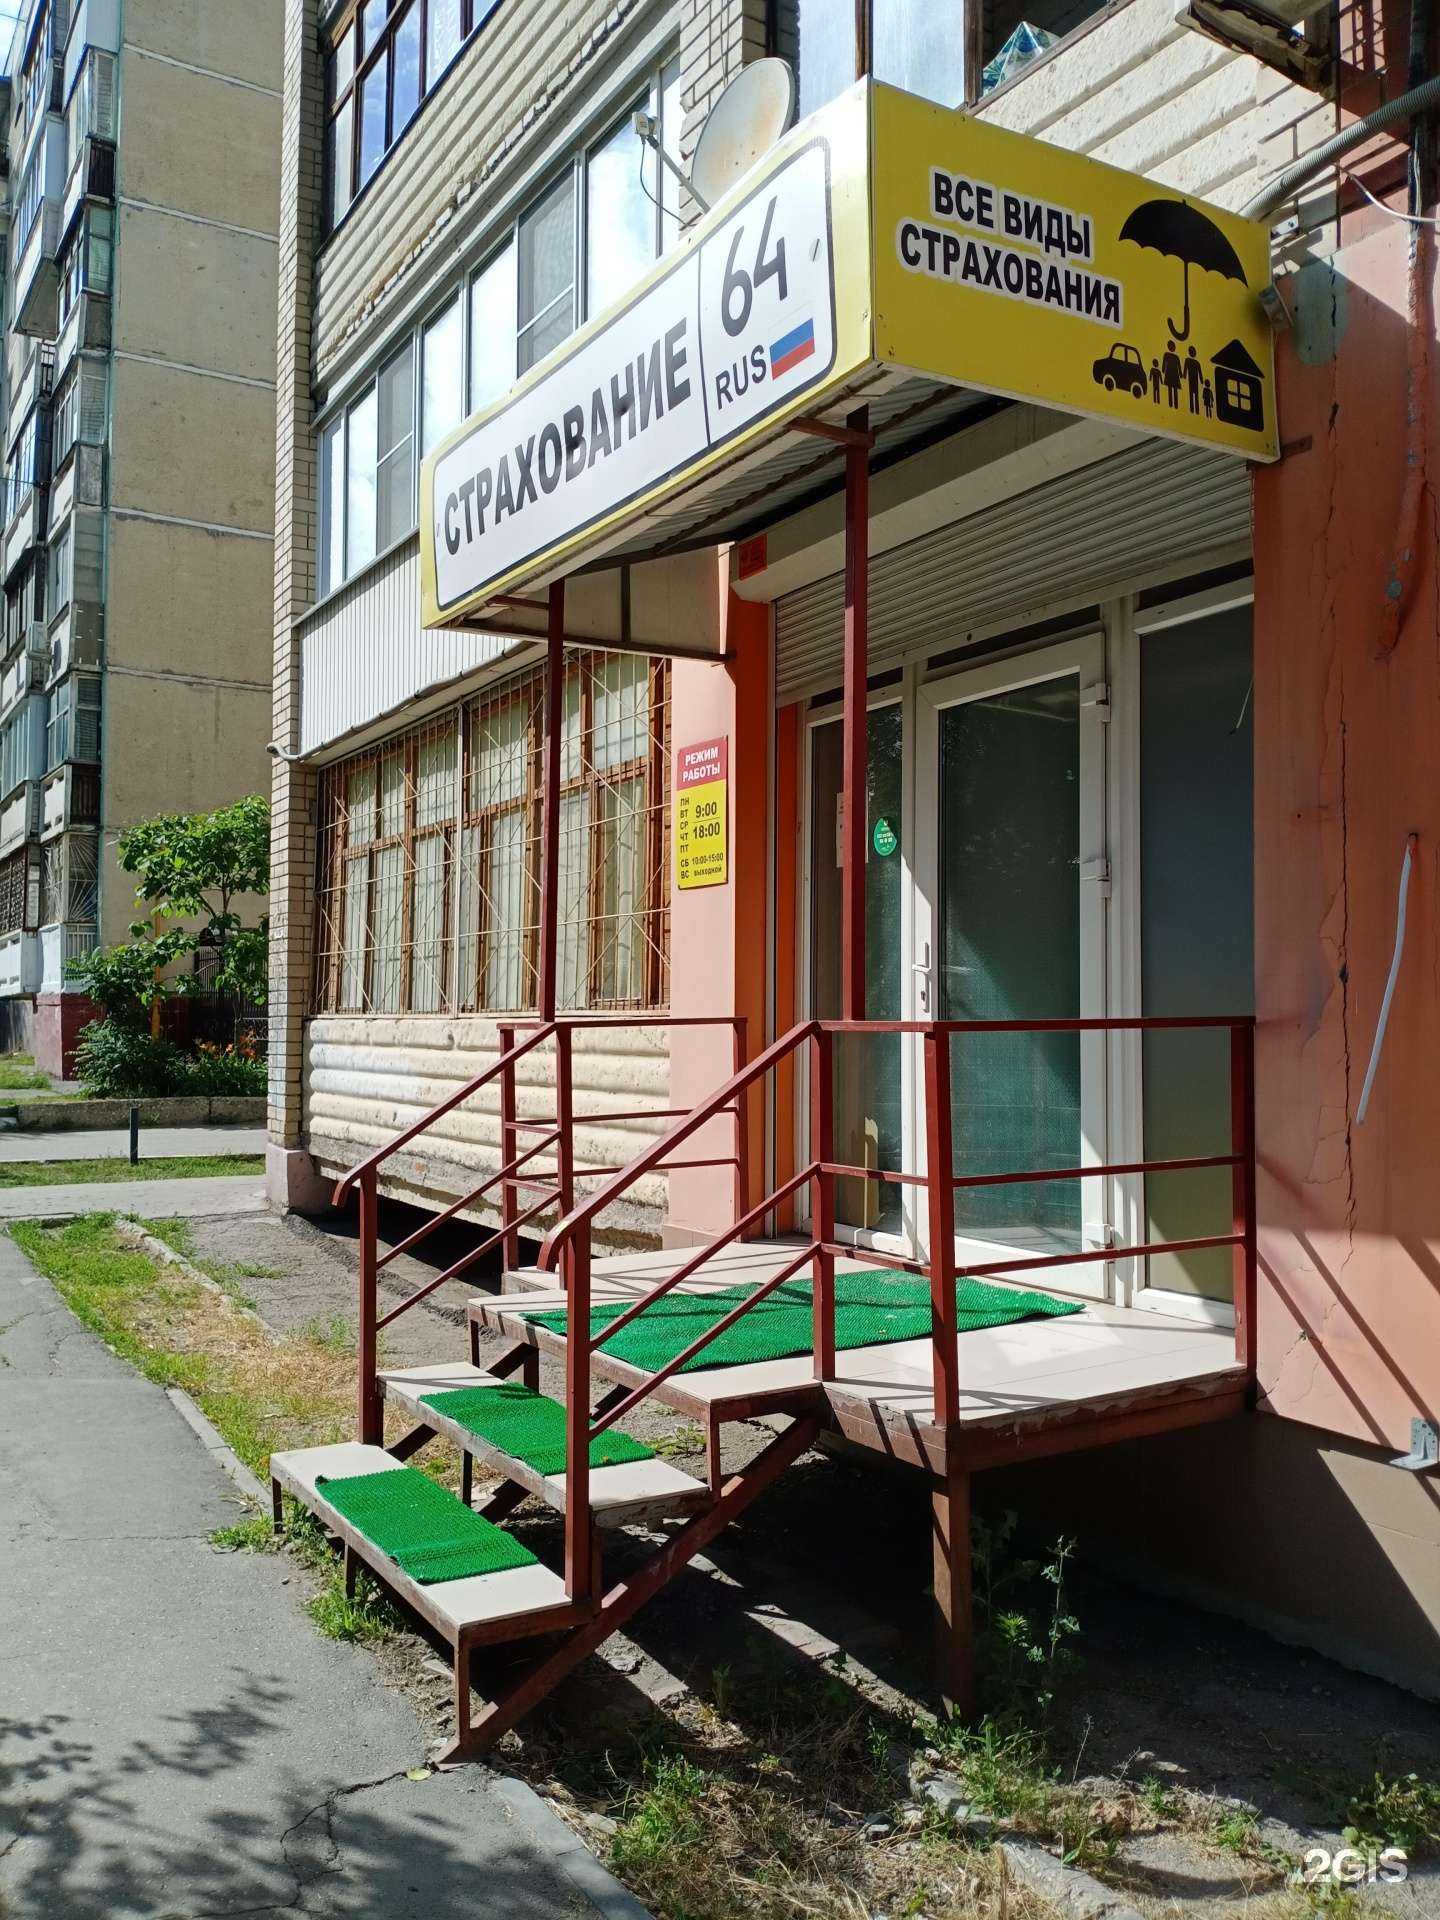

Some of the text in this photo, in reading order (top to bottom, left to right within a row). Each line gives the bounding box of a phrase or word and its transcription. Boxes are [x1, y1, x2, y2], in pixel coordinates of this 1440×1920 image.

[934, 172, 1091, 258] ВСЕ ВИДЫ
[721, 195, 788, 337] 64
[900, 223, 1121, 324] СТРАХОВАНИЯ
[716, 344, 767, 411] RUS
[443, 317, 691, 555] СТРАХОВАНИЕ
[685, 746, 718, 766] РЕЖИМ
[682, 763, 721, 782] РАБОТЫ
[680, 797, 690, 806] ПН
[695, 801, 717, 818] 9:00
[680, 809, 689, 818] ВТ
[680, 821, 689, 830] СР
[693, 821, 720, 840] 18:00
[680, 832, 689, 841] ЧТ
[680, 844, 689, 853] ПТ
[680, 859, 690, 868] СБ
[680, 870, 690, 879] ВС
